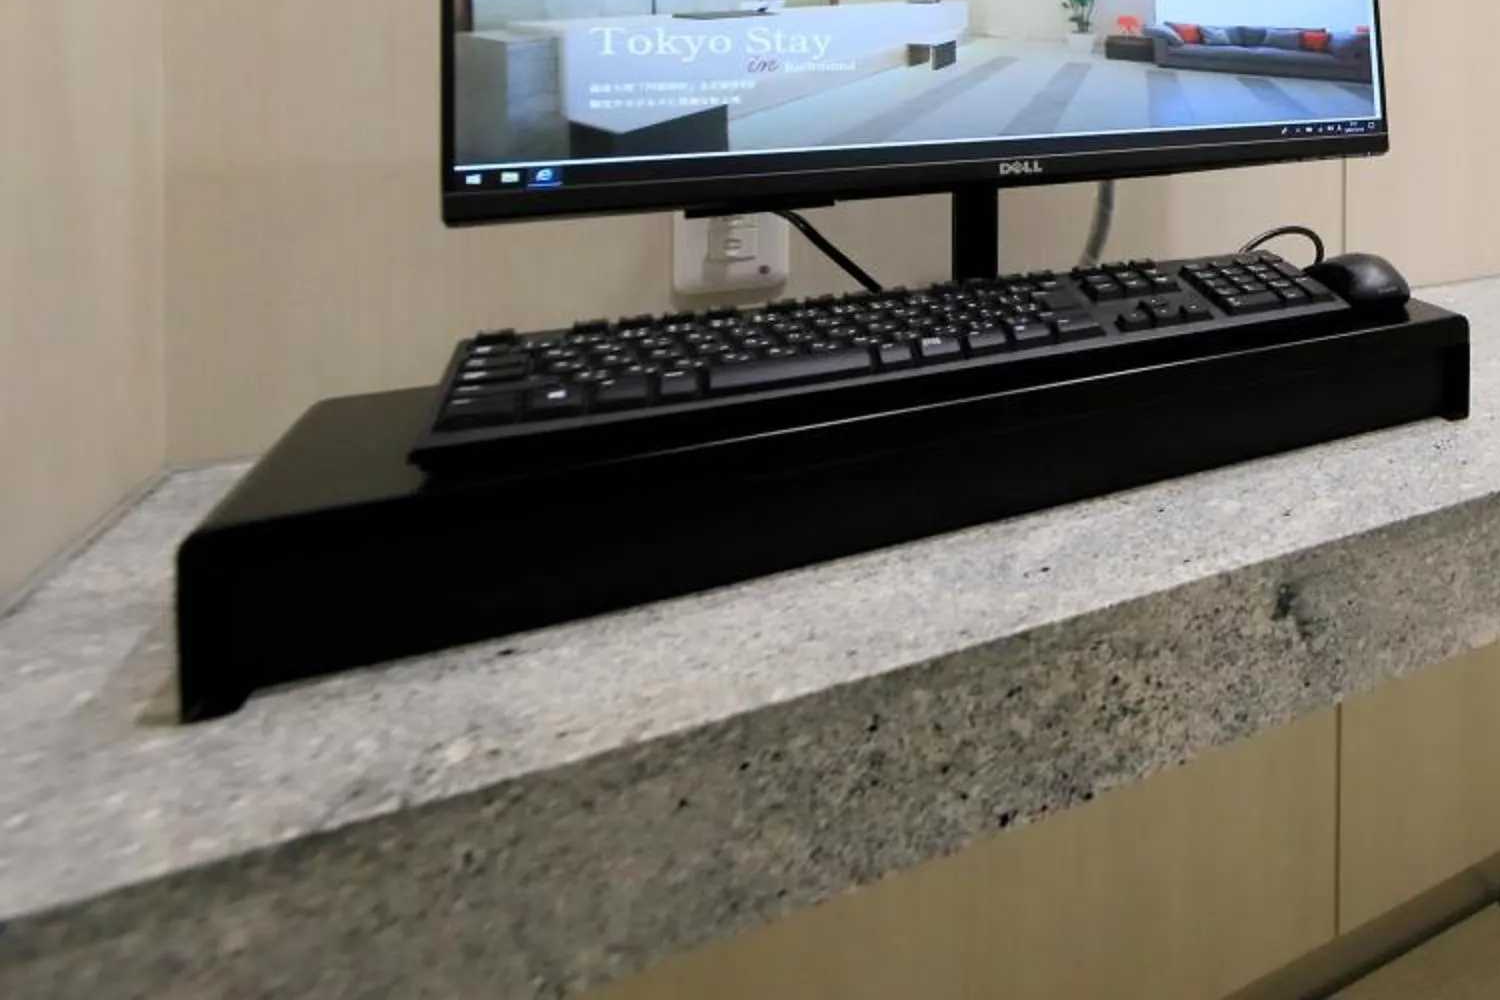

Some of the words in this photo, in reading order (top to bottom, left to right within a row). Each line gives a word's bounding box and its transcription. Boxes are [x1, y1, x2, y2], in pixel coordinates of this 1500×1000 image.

[589, 26, 732, 63] Tokyo
[746, 25, 833, 60] Stay
[999, 160, 1043, 175] DELL
